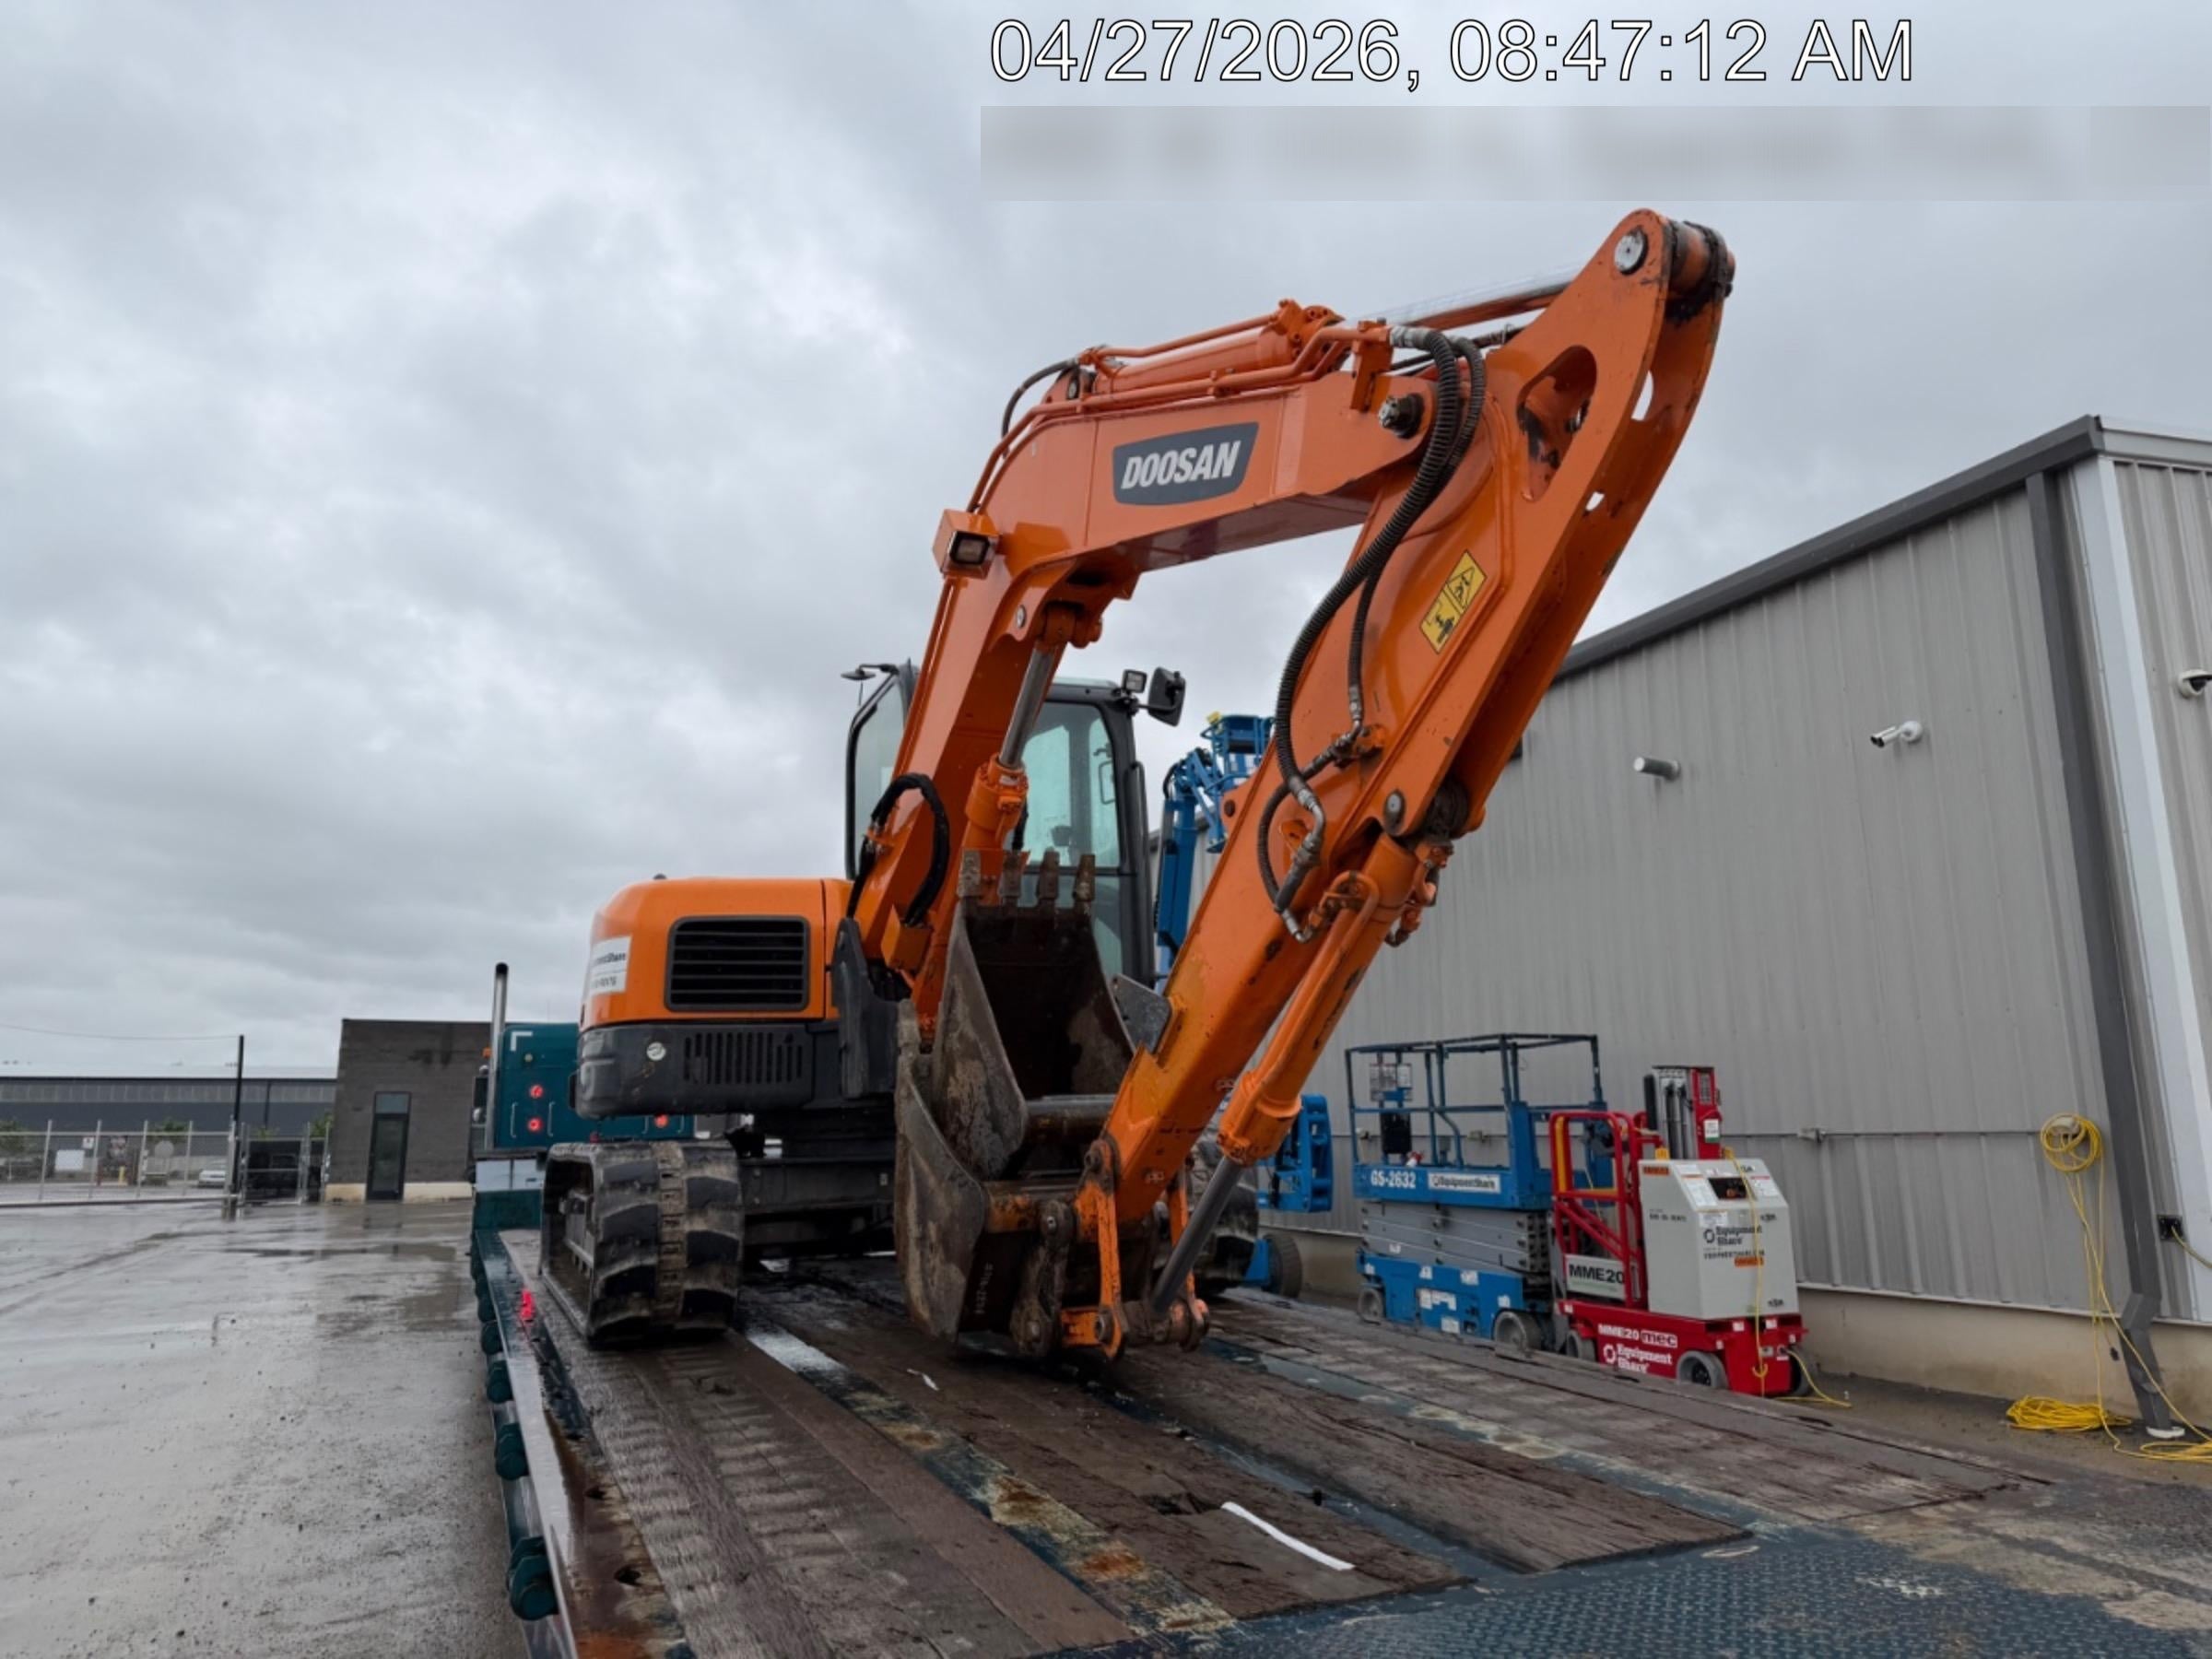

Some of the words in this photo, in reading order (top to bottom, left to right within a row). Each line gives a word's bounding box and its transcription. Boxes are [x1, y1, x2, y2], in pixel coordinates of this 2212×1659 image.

[1121, 440, 1241, 489] DOOSAN
[1370, 1170, 1417, 1189] GS-2632
[1569, 1264, 1626, 1284] MME20
[1597, 1324, 1640, 1340] MME20
[1617, 1344, 1672, 1365] Equipment
